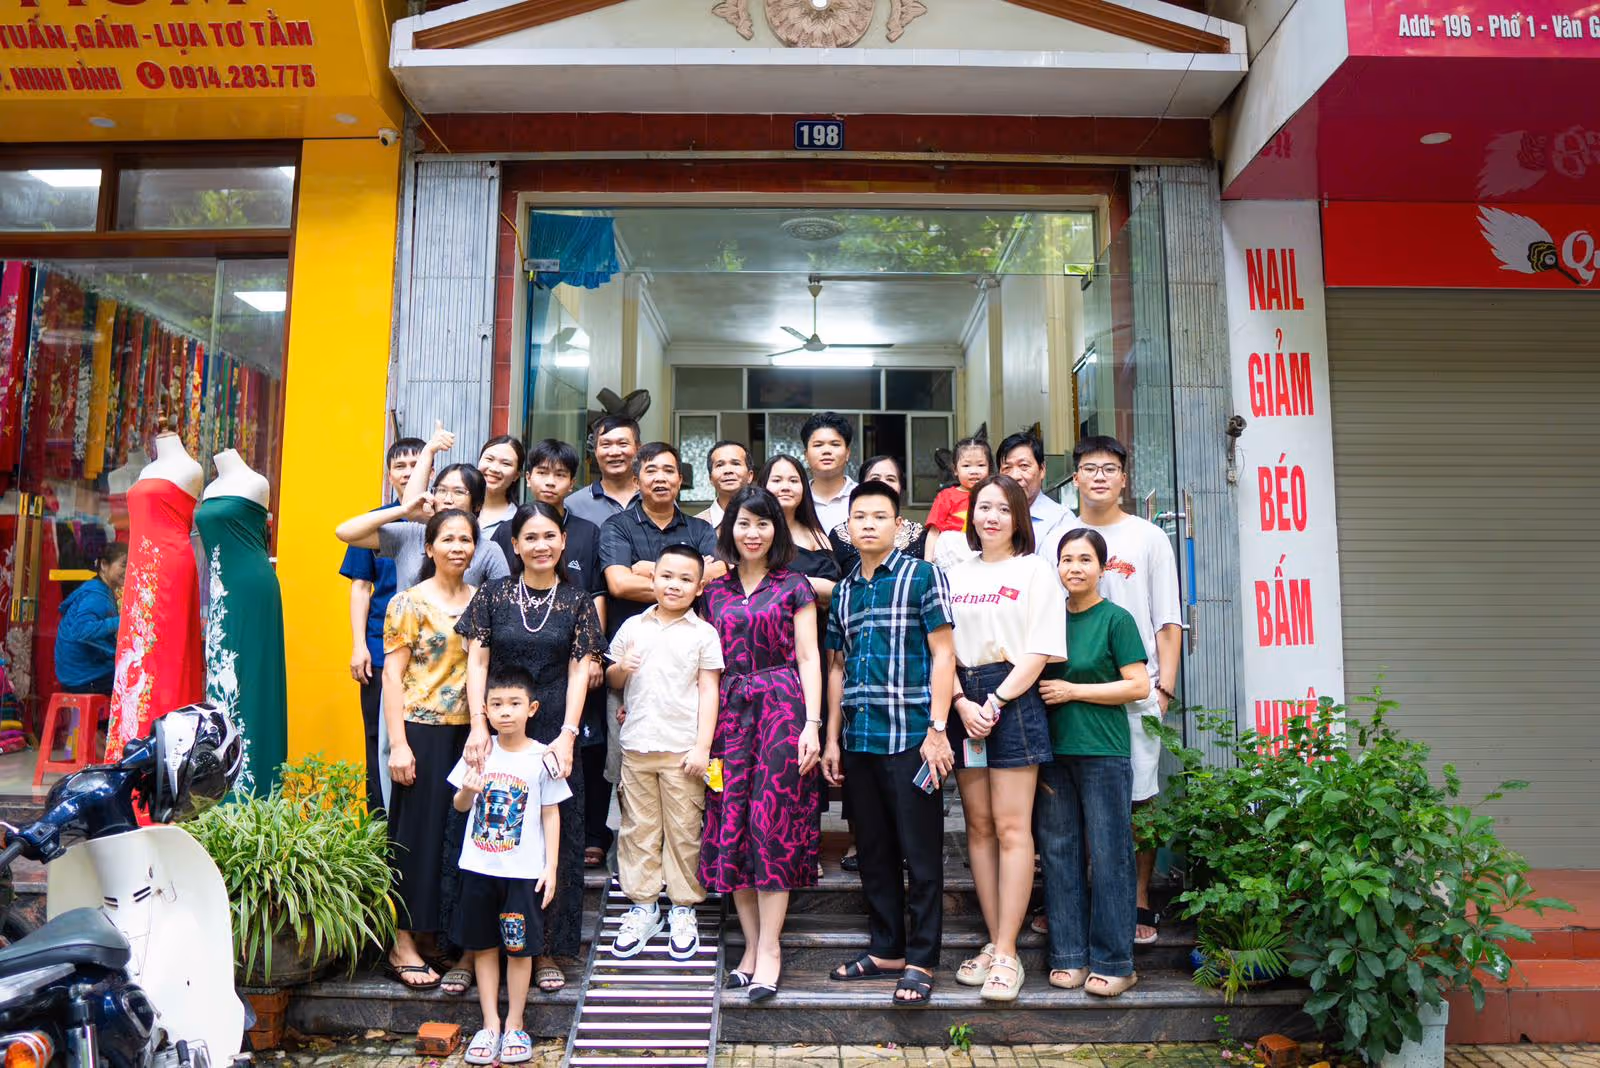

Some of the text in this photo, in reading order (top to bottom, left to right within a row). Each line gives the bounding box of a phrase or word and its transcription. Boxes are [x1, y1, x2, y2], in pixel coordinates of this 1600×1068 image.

[153, 22, 209, 56] LỤA
[208, 20, 246, 48] TƠ
[1399, 14, 1436, 38] Add:
[1442, 14, 1472, 38] 196
[1488, 12, 1522, 38] Phố
[1526, 15, 1536, 38] 1
[1551, 15, 1584, 39] Vân
[9, 66, 69, 91] NINH
[66, 58, 123, 91] BÌNH
[168, 64, 316, 90] 0914.283.775
[799, 124, 840, 146] 198
[1245, 248, 1305, 311] NAIL
[1561, 230, 1600, 287] Q
[1247, 327, 1315, 418] GIẢM
[1257, 452, 1308, 532] BÉO
[950, 592, 1001, 605] ietnam
[1254, 553, 1315, 647] BẤM
